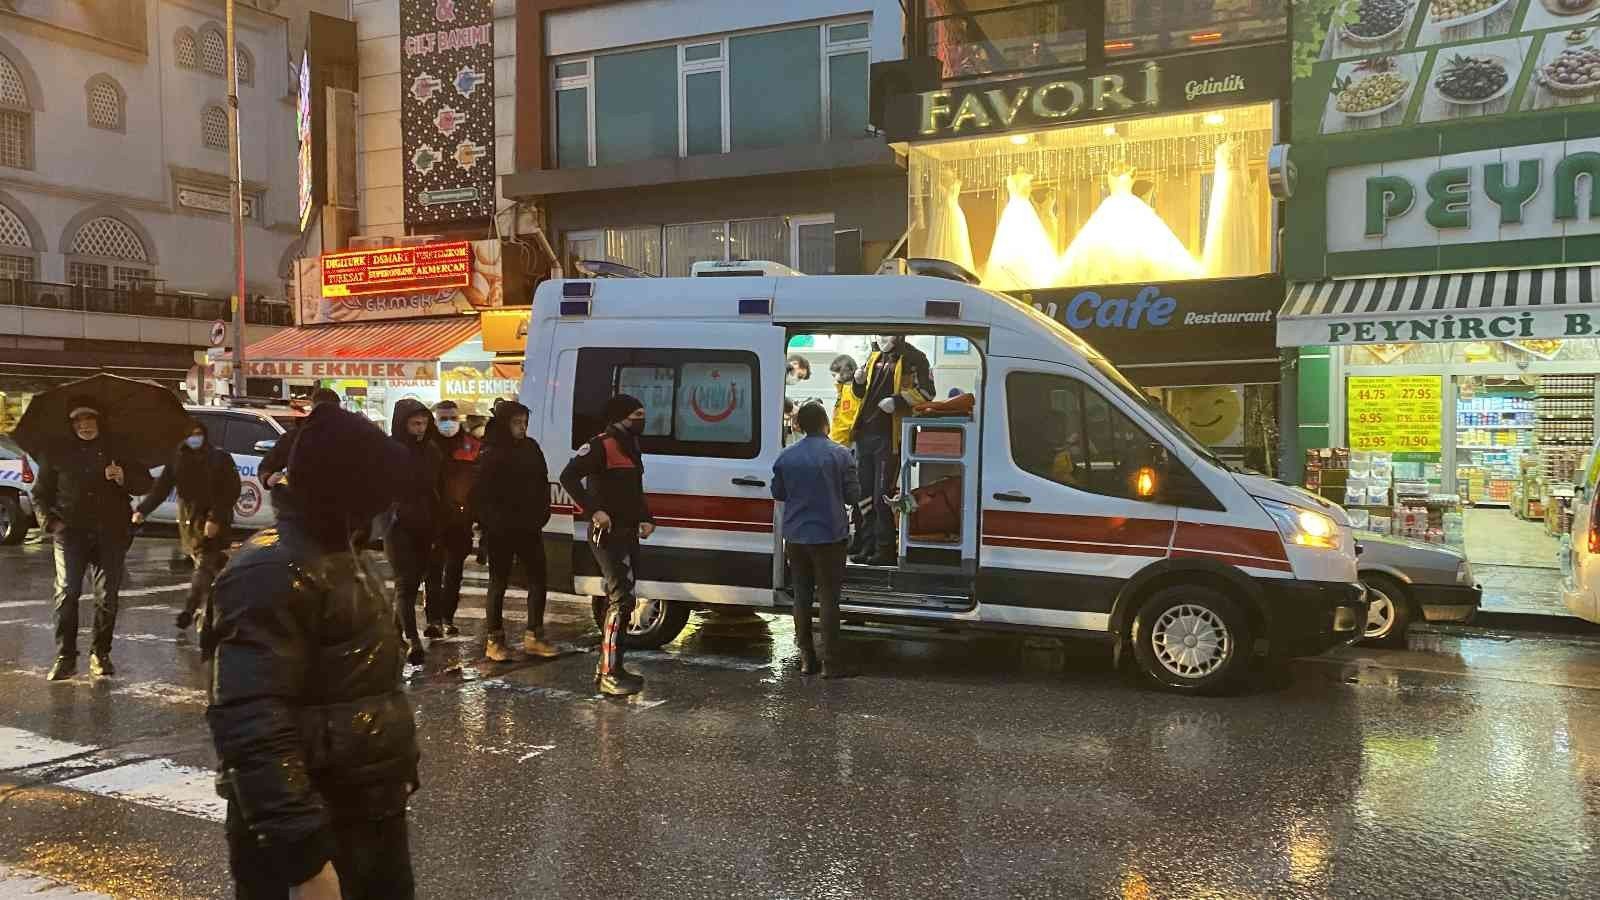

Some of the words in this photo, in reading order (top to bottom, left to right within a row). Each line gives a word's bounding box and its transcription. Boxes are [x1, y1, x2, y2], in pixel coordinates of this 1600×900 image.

[1185, 74, 1246, 101] Gelinlik
[917, 60, 1165, 135] FAVORİ
[1065, 286, 1177, 329] Cafe
[1184, 309, 1273, 326] Restaurant
[1327, 311, 1535, 343] PEYNİRCİ
[1563, 312, 1600, 336] B
[246, 362, 304, 376] KALE
[311, 362, 405, 377] EKMEK
[446, 380, 476, 395] KALE
[478, 379, 520, 395] EKMEK
[1401, 388, 1432, 399] 27.95
[1359, 412, 1382, 423] 9.95
[235, 465, 256, 477] POL
